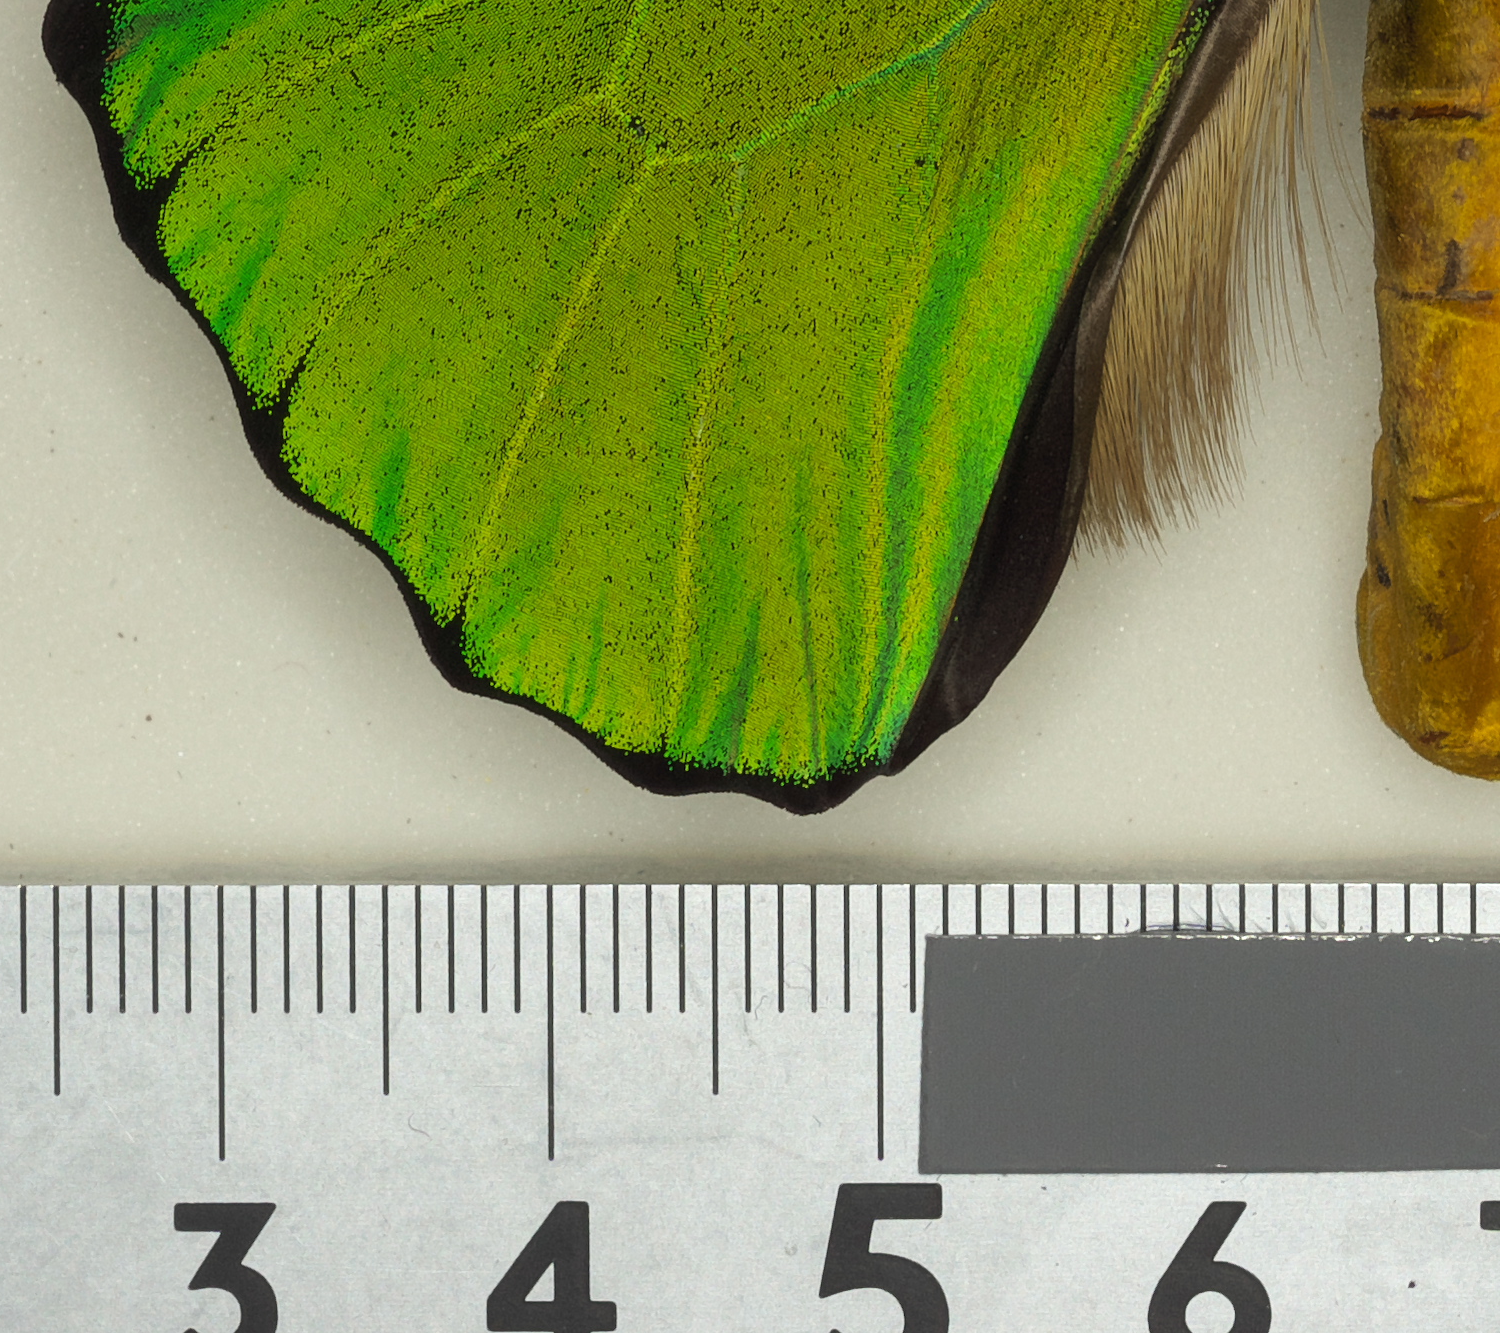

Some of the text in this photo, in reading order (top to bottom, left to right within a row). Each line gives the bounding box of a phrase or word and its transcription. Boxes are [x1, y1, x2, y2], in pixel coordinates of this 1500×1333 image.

[172, 1201, 280, 1333] 3
[485, 1199, 619, 1333] 4
[817, 1181, 951, 1333] 5
[1146, 1199, 1273, 1333] 6
